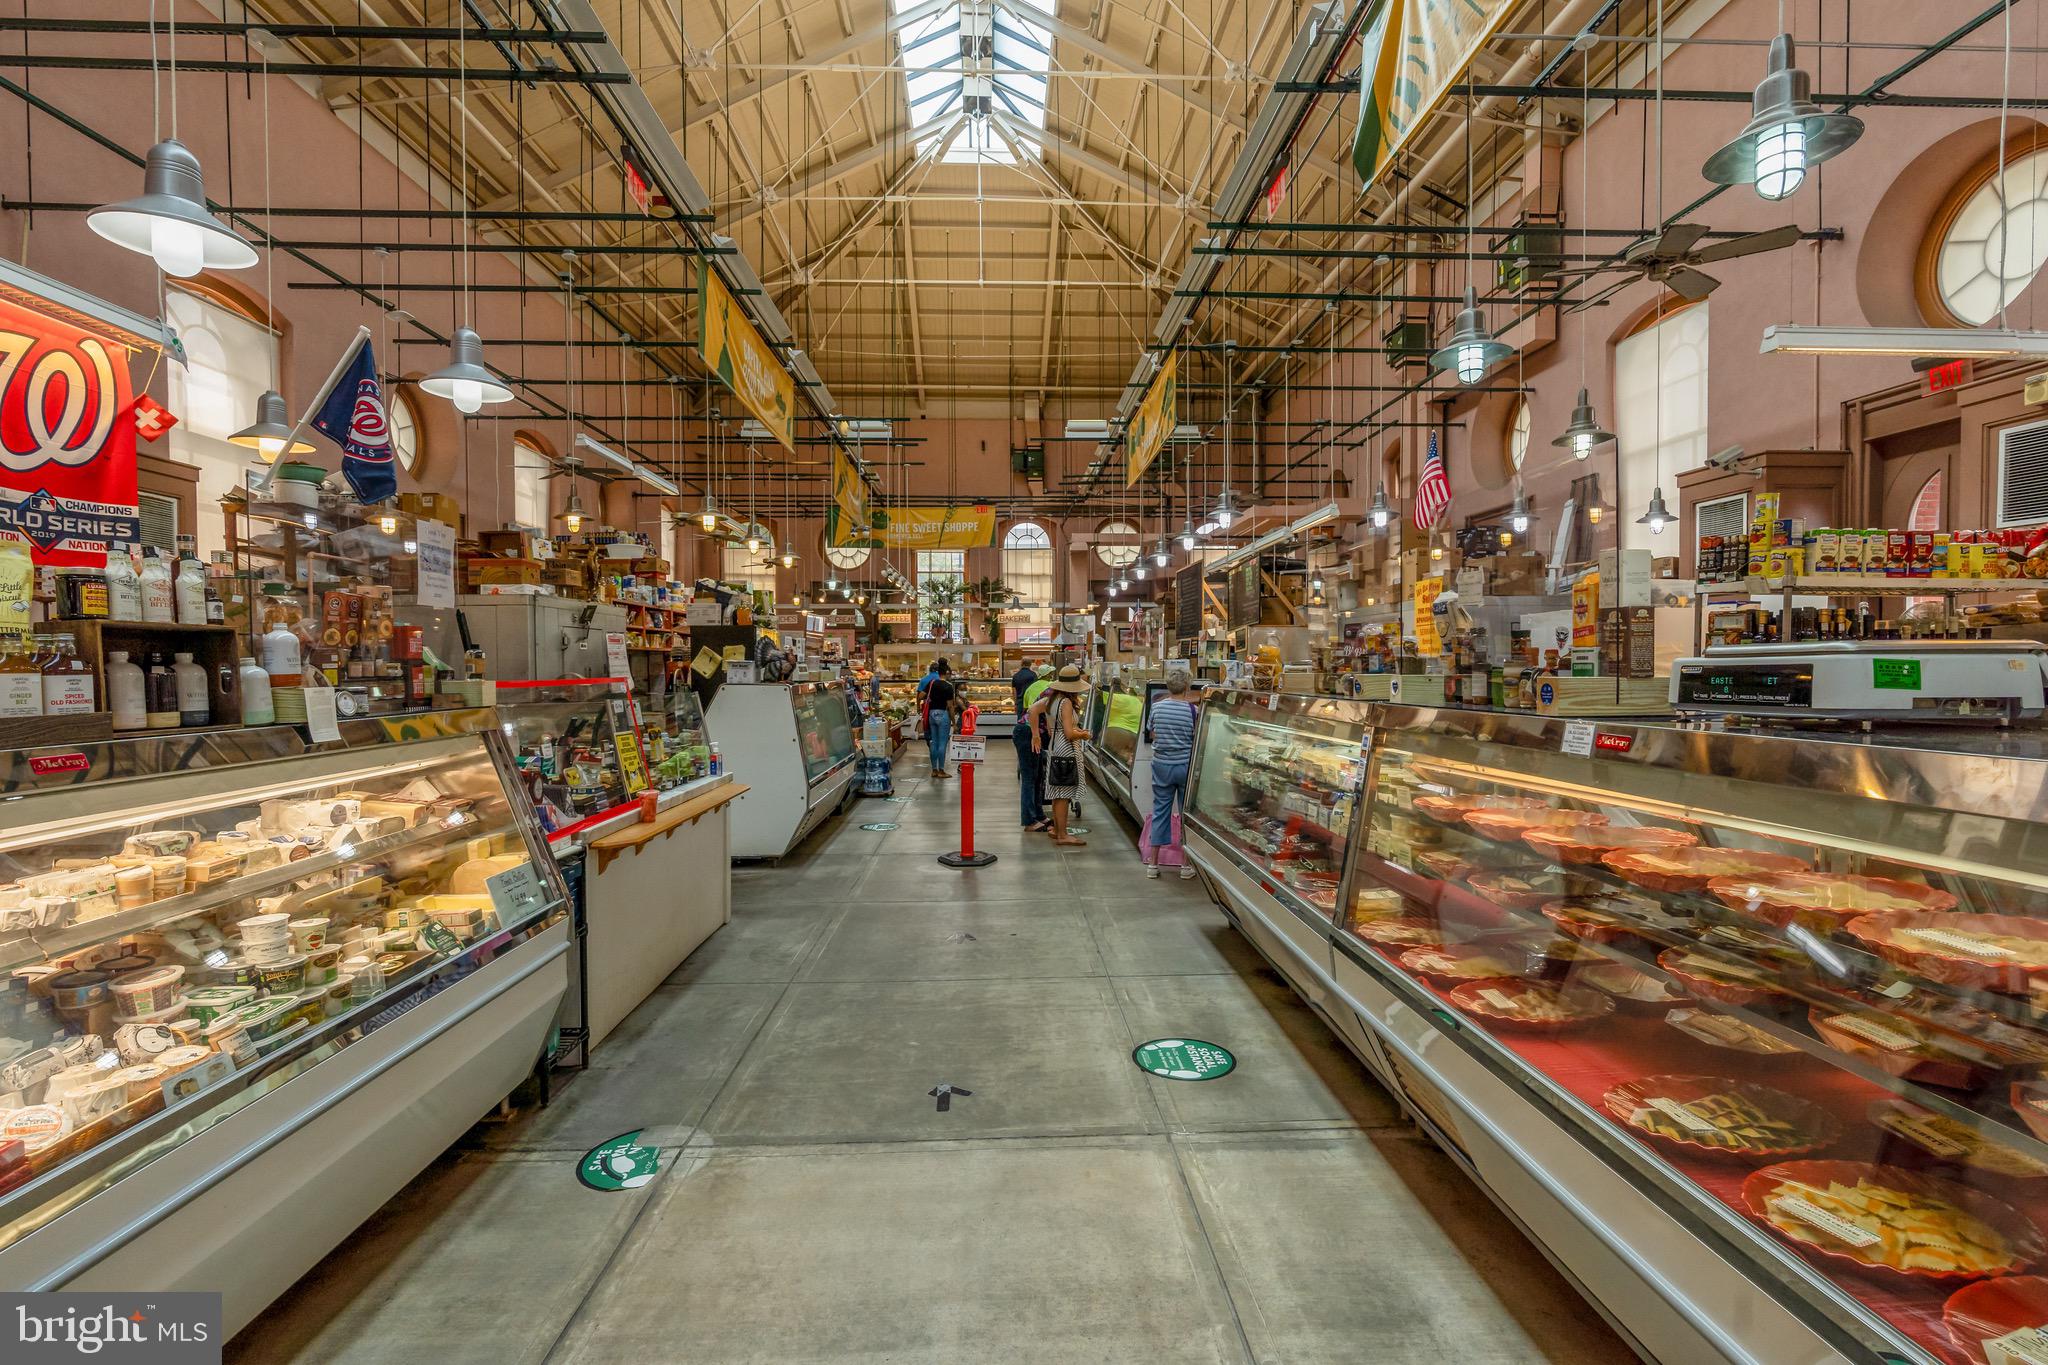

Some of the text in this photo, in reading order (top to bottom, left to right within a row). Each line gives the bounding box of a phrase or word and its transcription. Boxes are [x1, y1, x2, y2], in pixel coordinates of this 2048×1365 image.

[1929, 360, 1964, 391] EXIT
[65, 501, 133, 516] CHAMPIONS
[48, 515, 132, 537] SERIES
[890, 521, 979, 533] FINE SWEET SHOPPE
[31, 530, 56, 538] 2019
[880, 614, 910, 623] COFFEE
[999, 614, 1029, 623] BAKERY
[1597, 735, 1630, 749] McCray
[33, 758, 85, 771] McCray
[1184, 1044, 1208, 1073] DISTANCE
[1198, 1047, 1218, 1069] SOCIAL
[1210, 1050, 1228, 1065] SAFE
